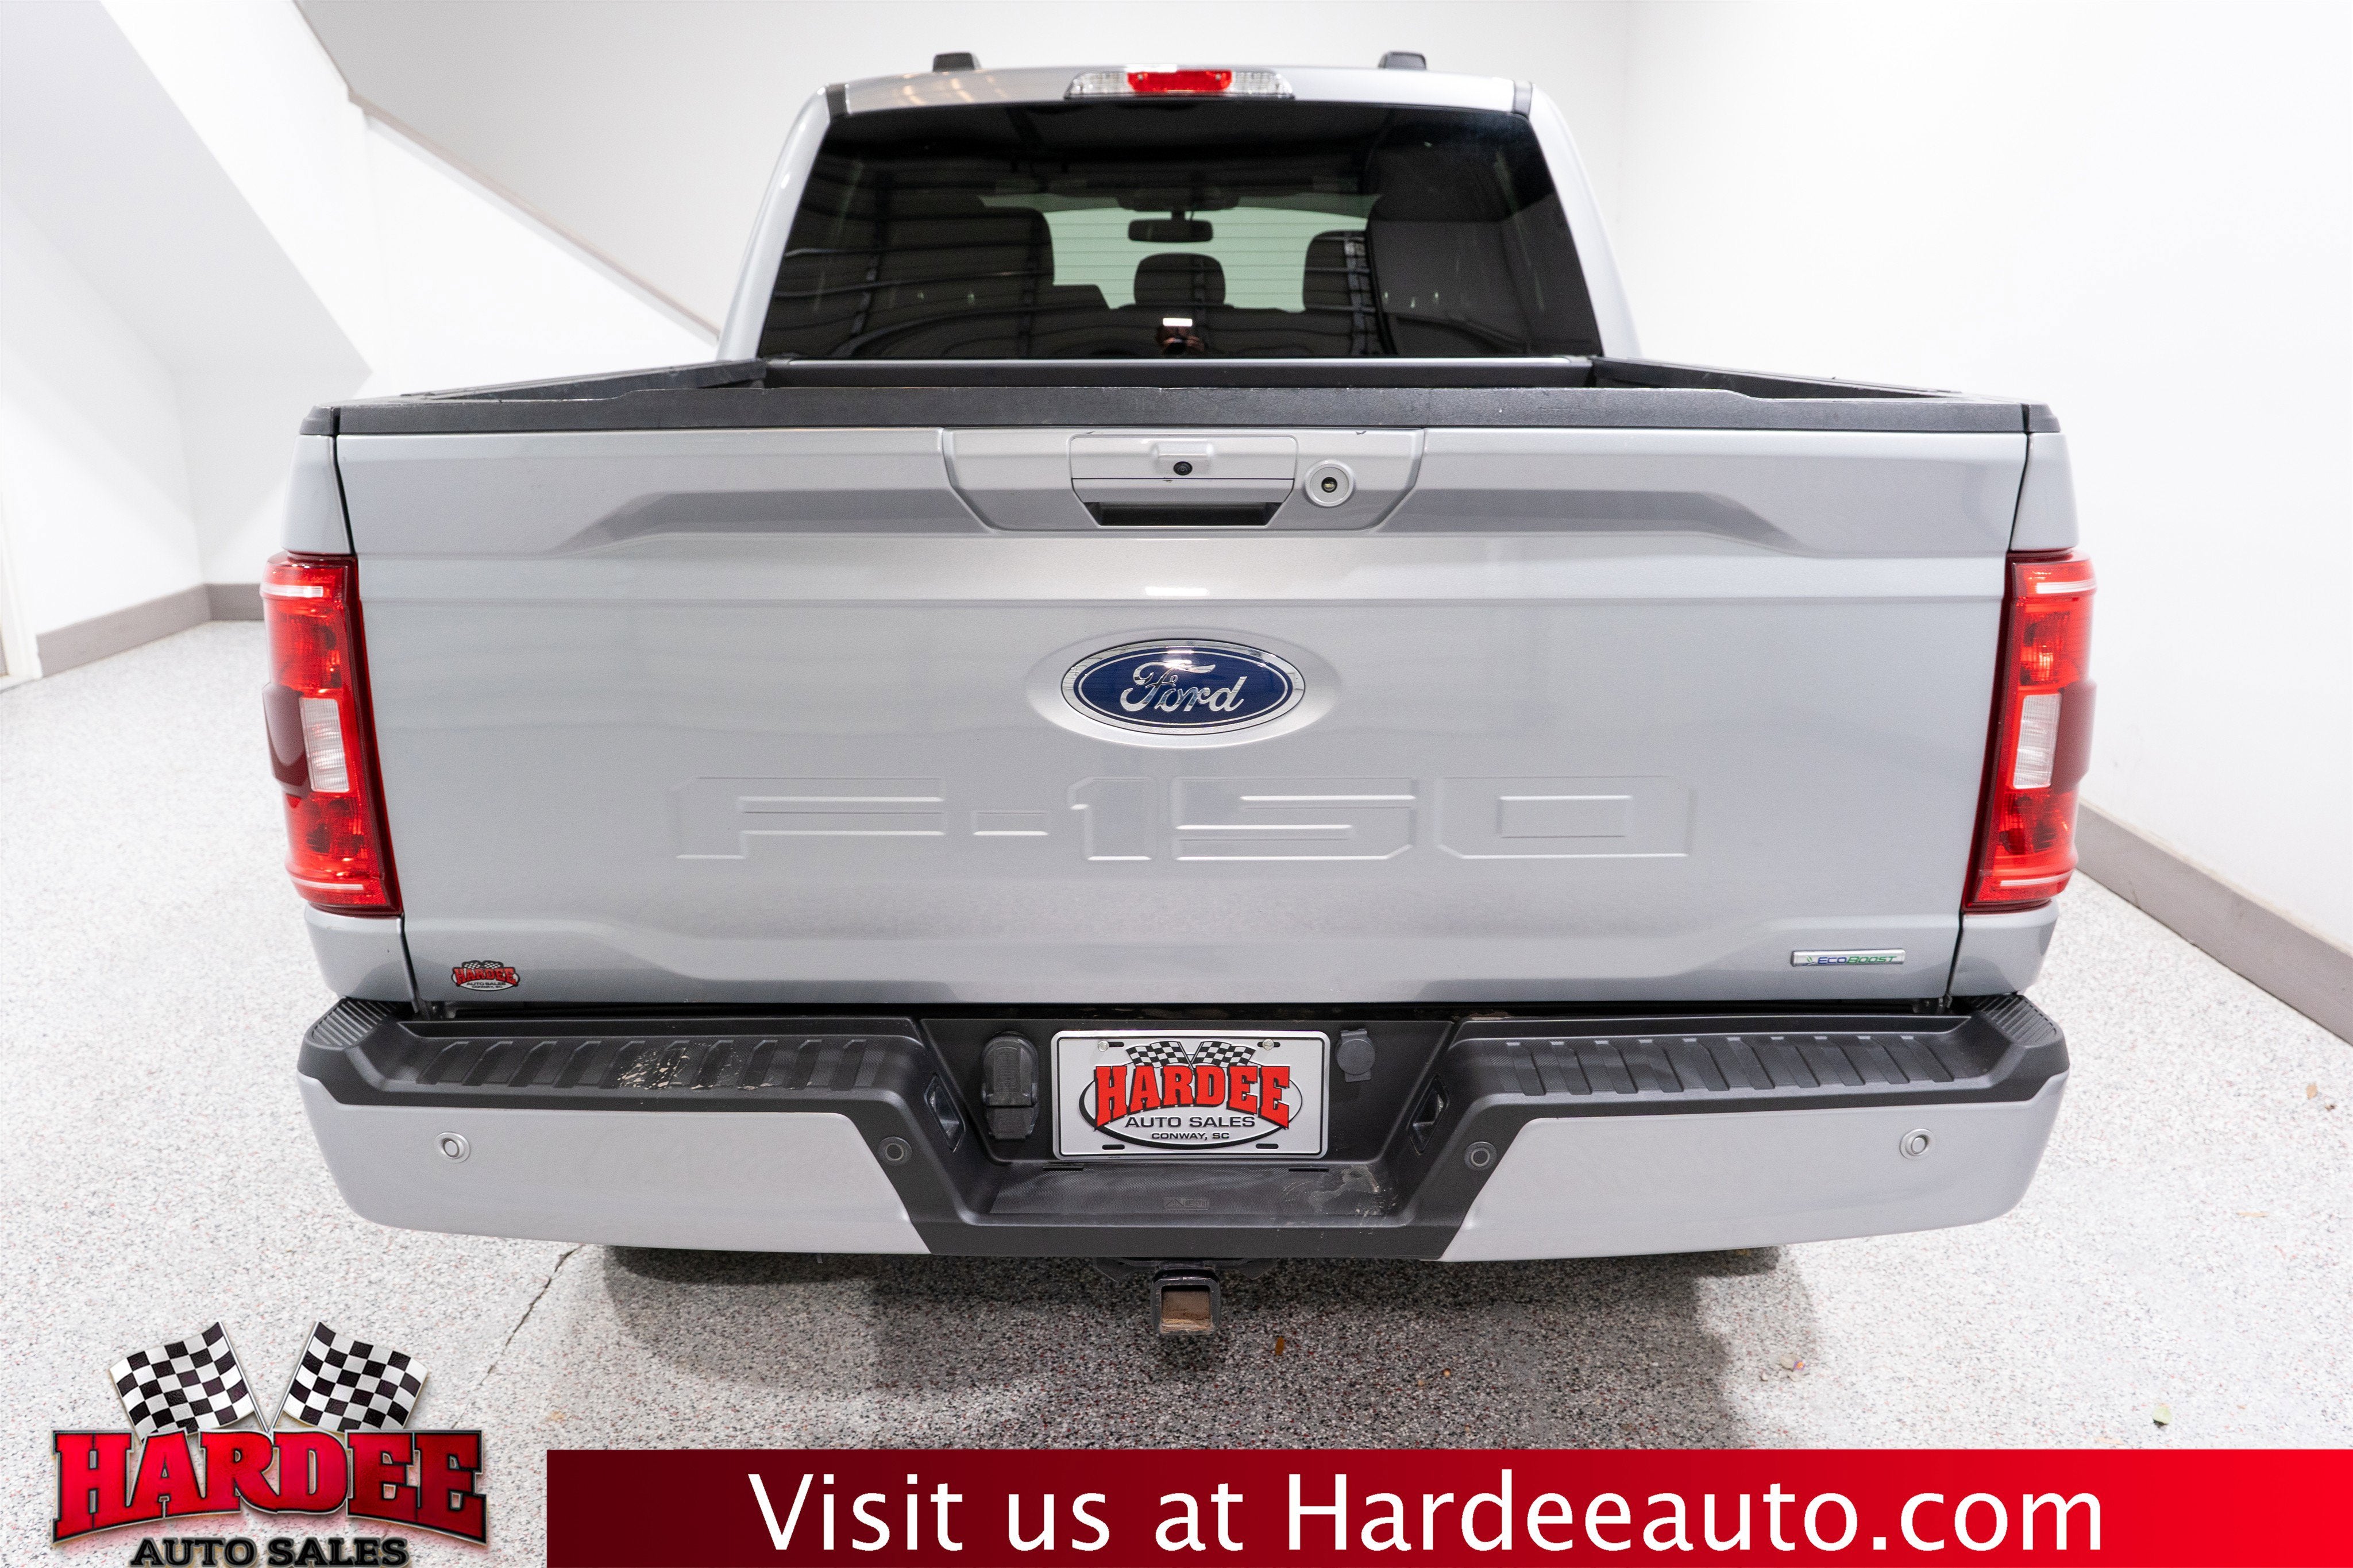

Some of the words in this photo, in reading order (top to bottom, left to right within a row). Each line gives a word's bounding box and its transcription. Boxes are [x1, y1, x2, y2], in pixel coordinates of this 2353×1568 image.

[1120, 661, 1244, 712] Ford
[670, 776, 1694, 860] F-150
[453, 967, 518, 986] HARDEE
[1094, 1065, 1290, 1130] HARDEE
[1125, 1117, 1182, 1127] AUTO
[1189, 1117, 1255, 1127] SALES
[1151, 1132, 1208, 1140] CONWAY,
